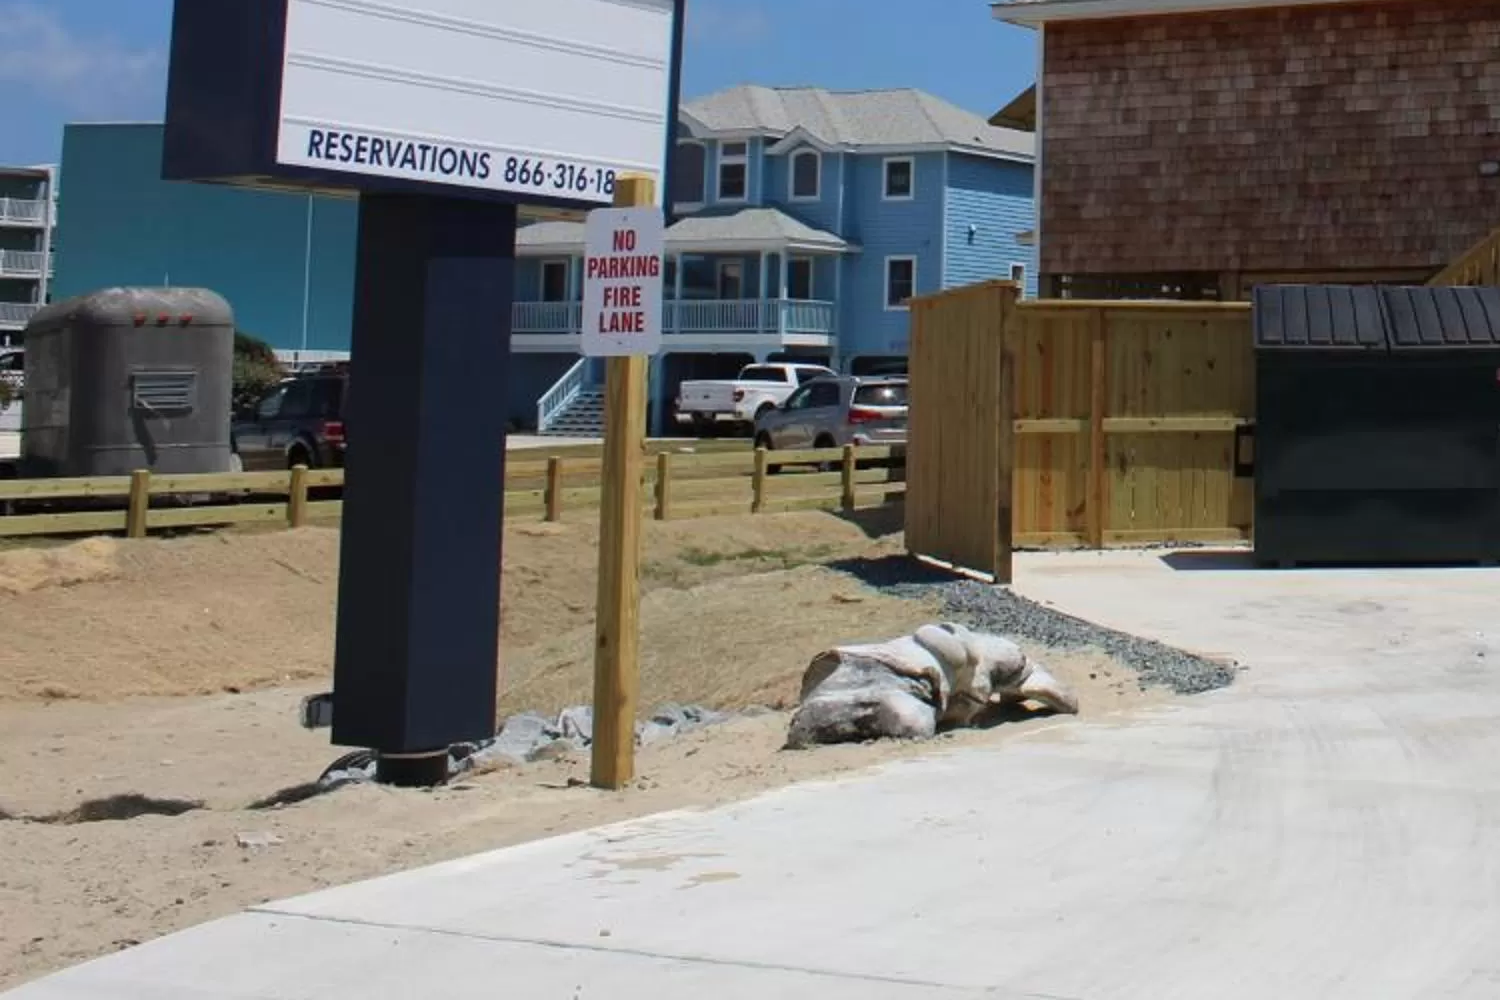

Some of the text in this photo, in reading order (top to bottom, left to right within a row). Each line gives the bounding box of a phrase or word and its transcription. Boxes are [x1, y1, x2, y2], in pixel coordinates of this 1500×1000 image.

[307, 129, 491, 179] RESERVATIONS
[613, 230, 636, 252] NO
[587, 256, 660, 279] PARKING
[602, 286, 642, 307] FIRE
[598, 312, 644, 334] LANE
